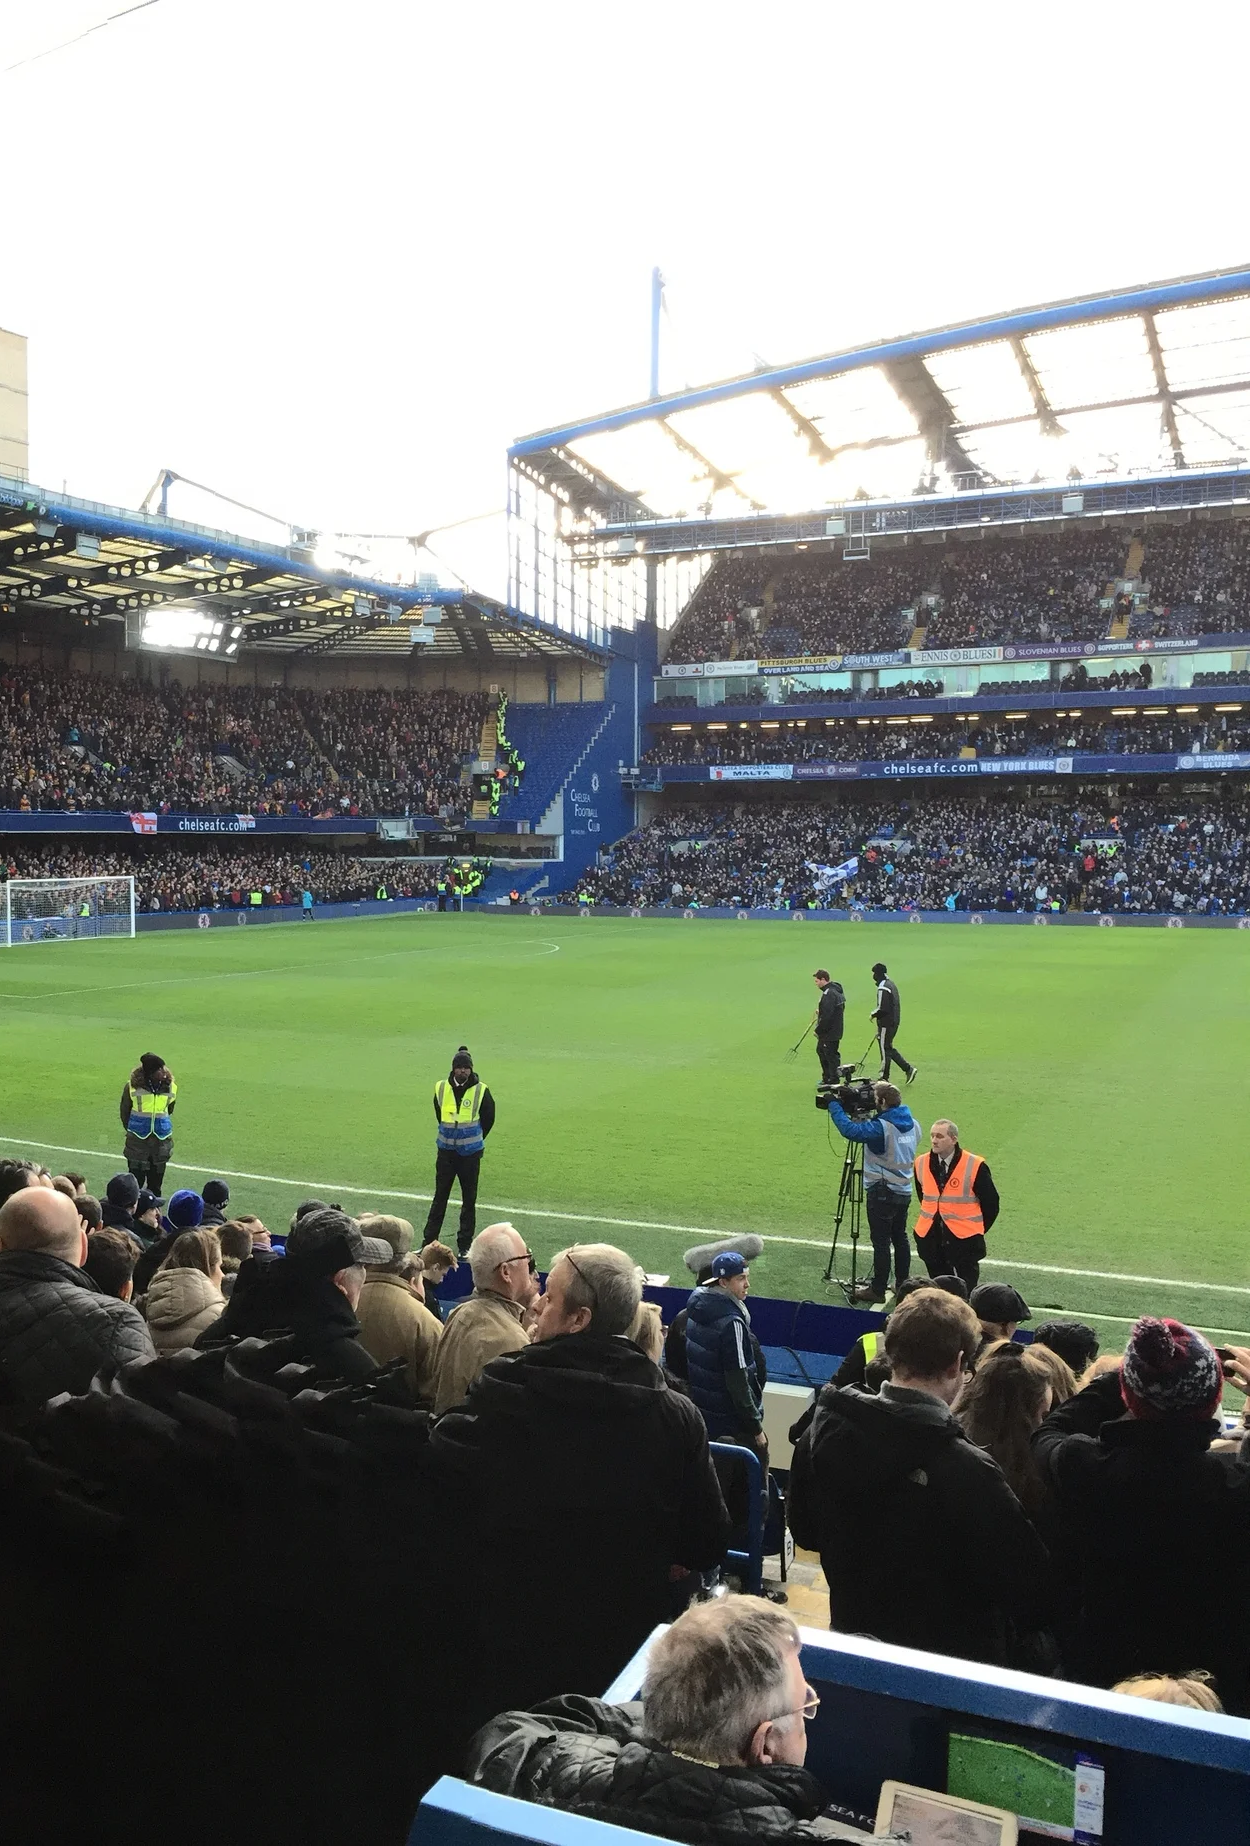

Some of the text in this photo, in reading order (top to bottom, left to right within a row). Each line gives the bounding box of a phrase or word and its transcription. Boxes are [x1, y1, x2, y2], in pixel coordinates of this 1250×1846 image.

[1154, 639, 1199, 648] SWITZERLAND
[962, 649, 993, 660] BLUES
[1018, 645, 1082, 656] SLOVENIAN BLUES
[760, 658, 803, 666] PITTSBURGH
[872, 654, 893, 663] WEST
[1196, 754, 1240, 762] BERMUDA
[884, 762, 978, 775] chelseafc.com
[981, 760, 1055, 773] NEW YORK BLUES
[1203, 761, 1233, 769] BLUES
